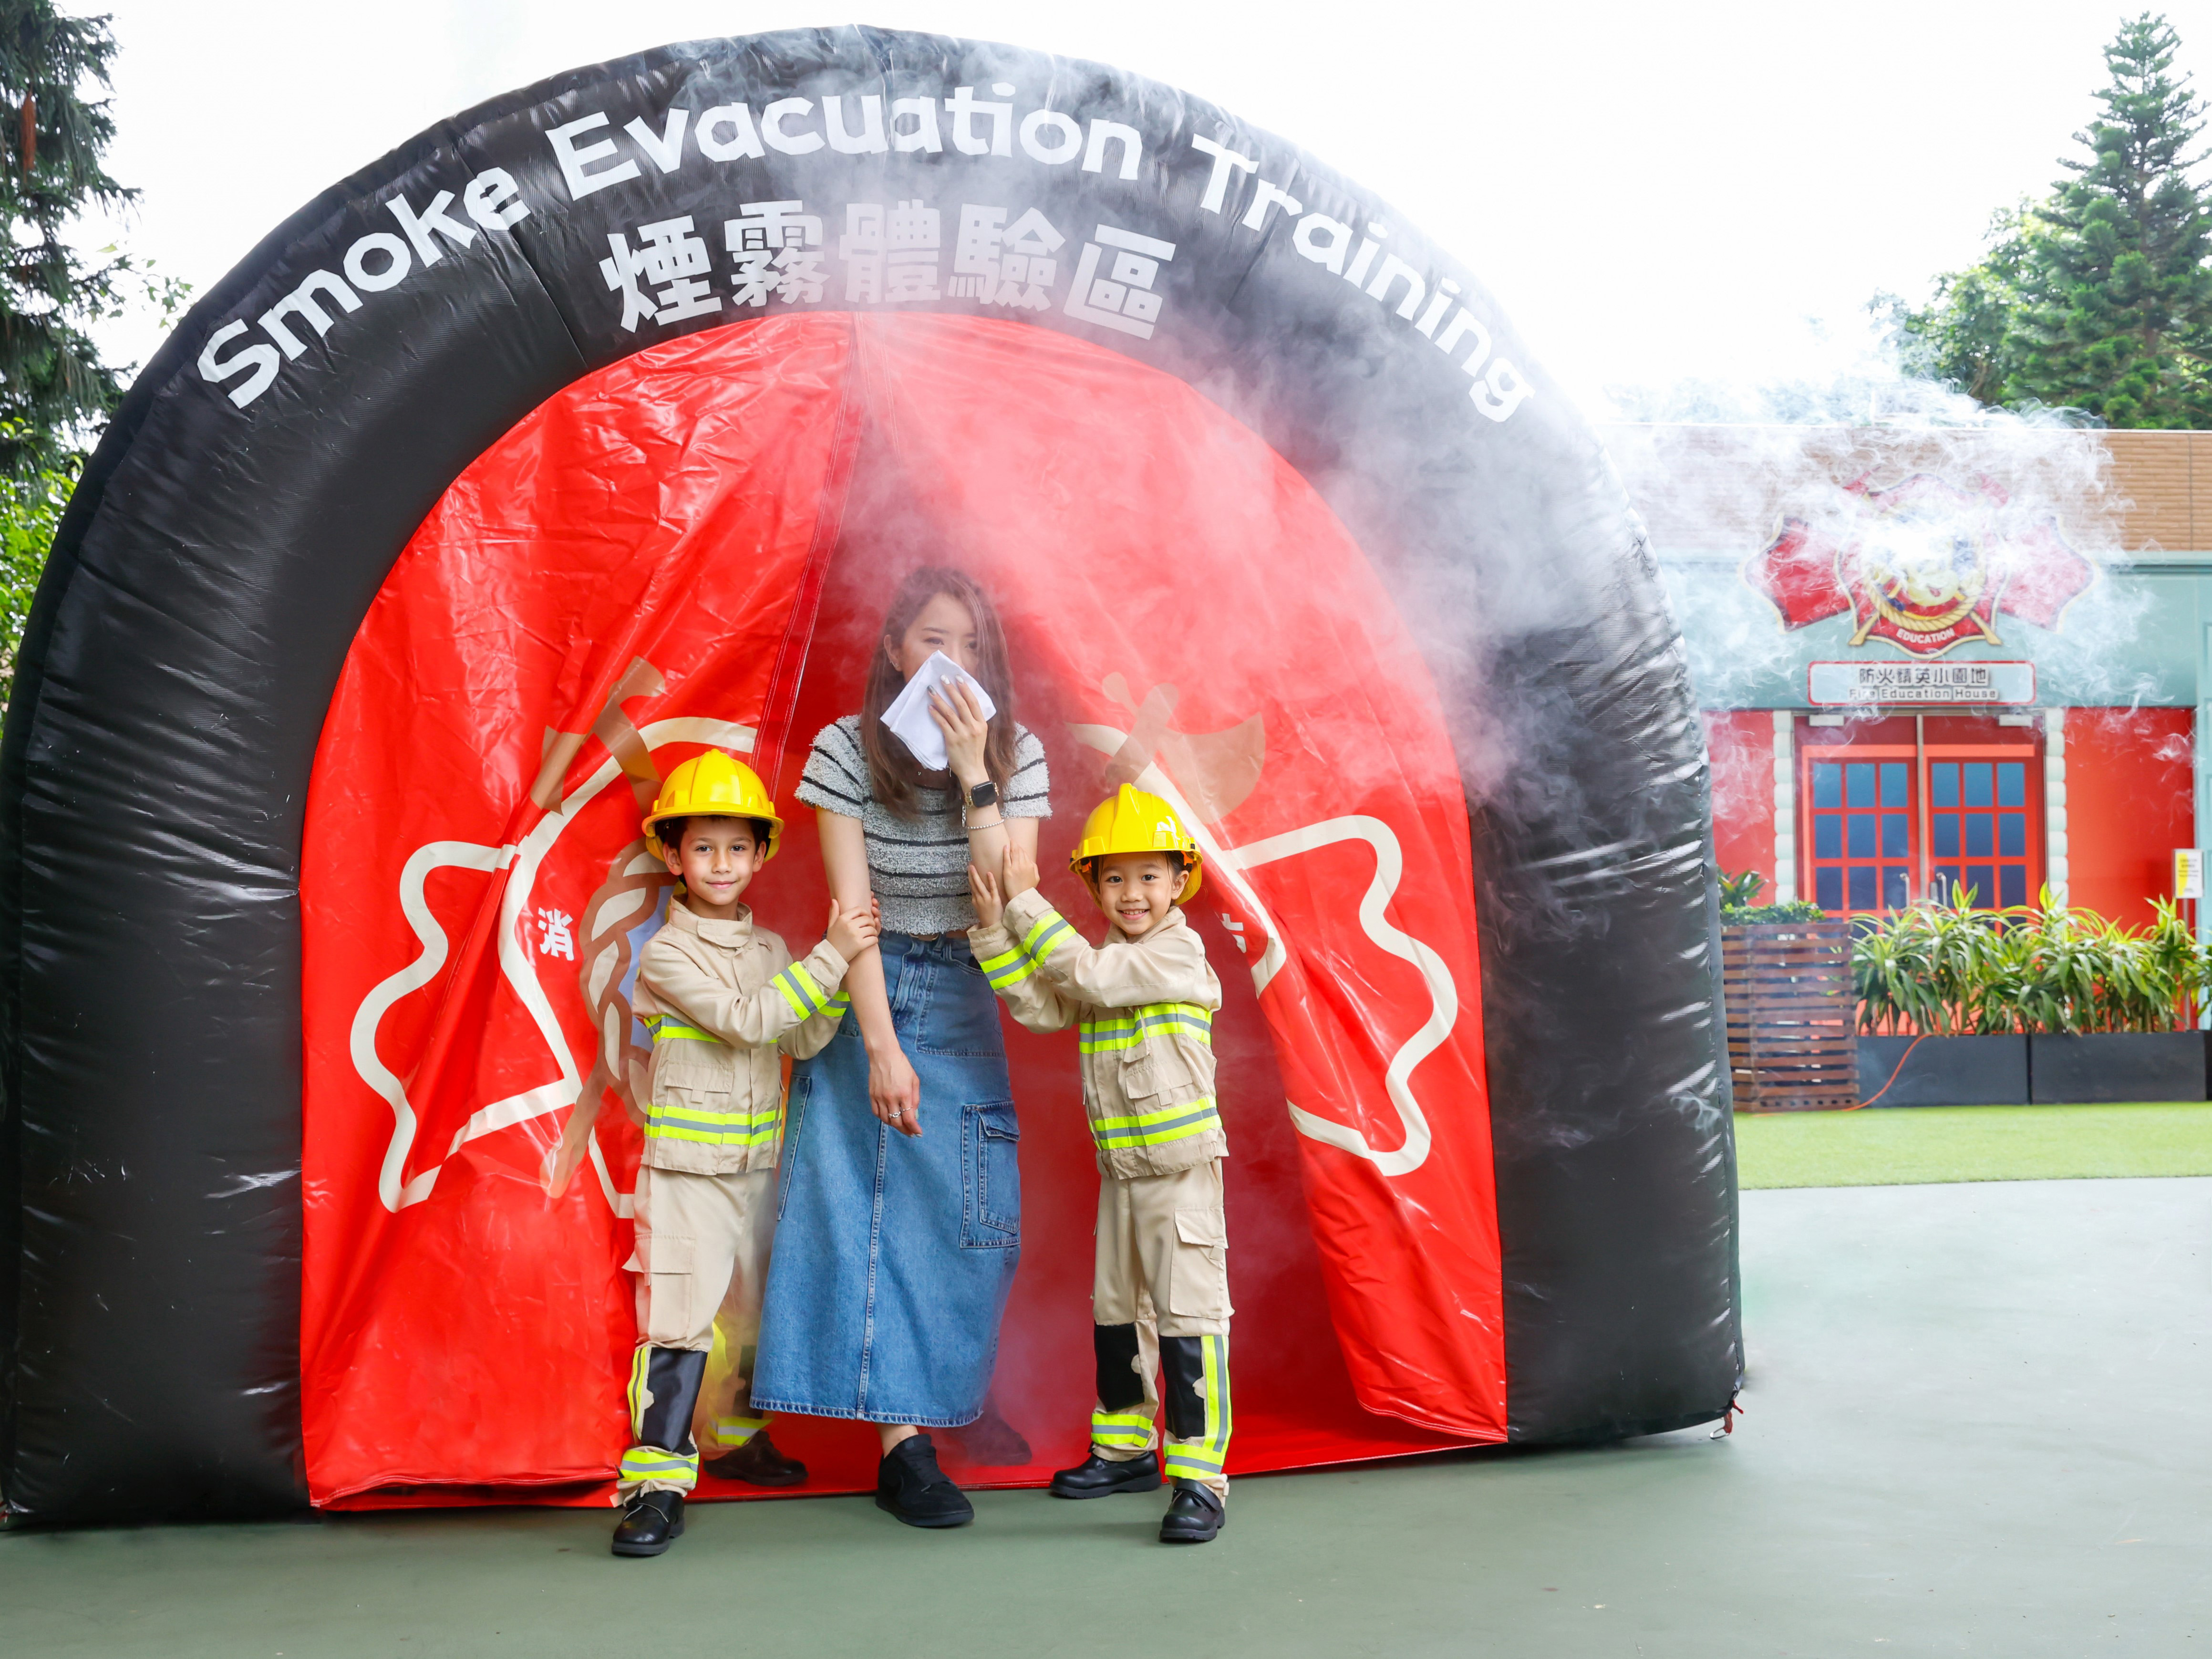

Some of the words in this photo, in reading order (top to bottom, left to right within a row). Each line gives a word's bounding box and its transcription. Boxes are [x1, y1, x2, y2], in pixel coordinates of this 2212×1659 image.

[197, 167, 531, 409] Smoke
[545, 82, 1142, 201] Evacuation
[1192, 134, 1535, 423] Training
[599, 198, 1176, 340] 煙霧體驗區
[1896, 627, 1955, 644] EDUCATION
[1881, 689, 1950, 698] Education
[1955, 689, 1997, 698] House
[538, 907, 575, 961] 消
